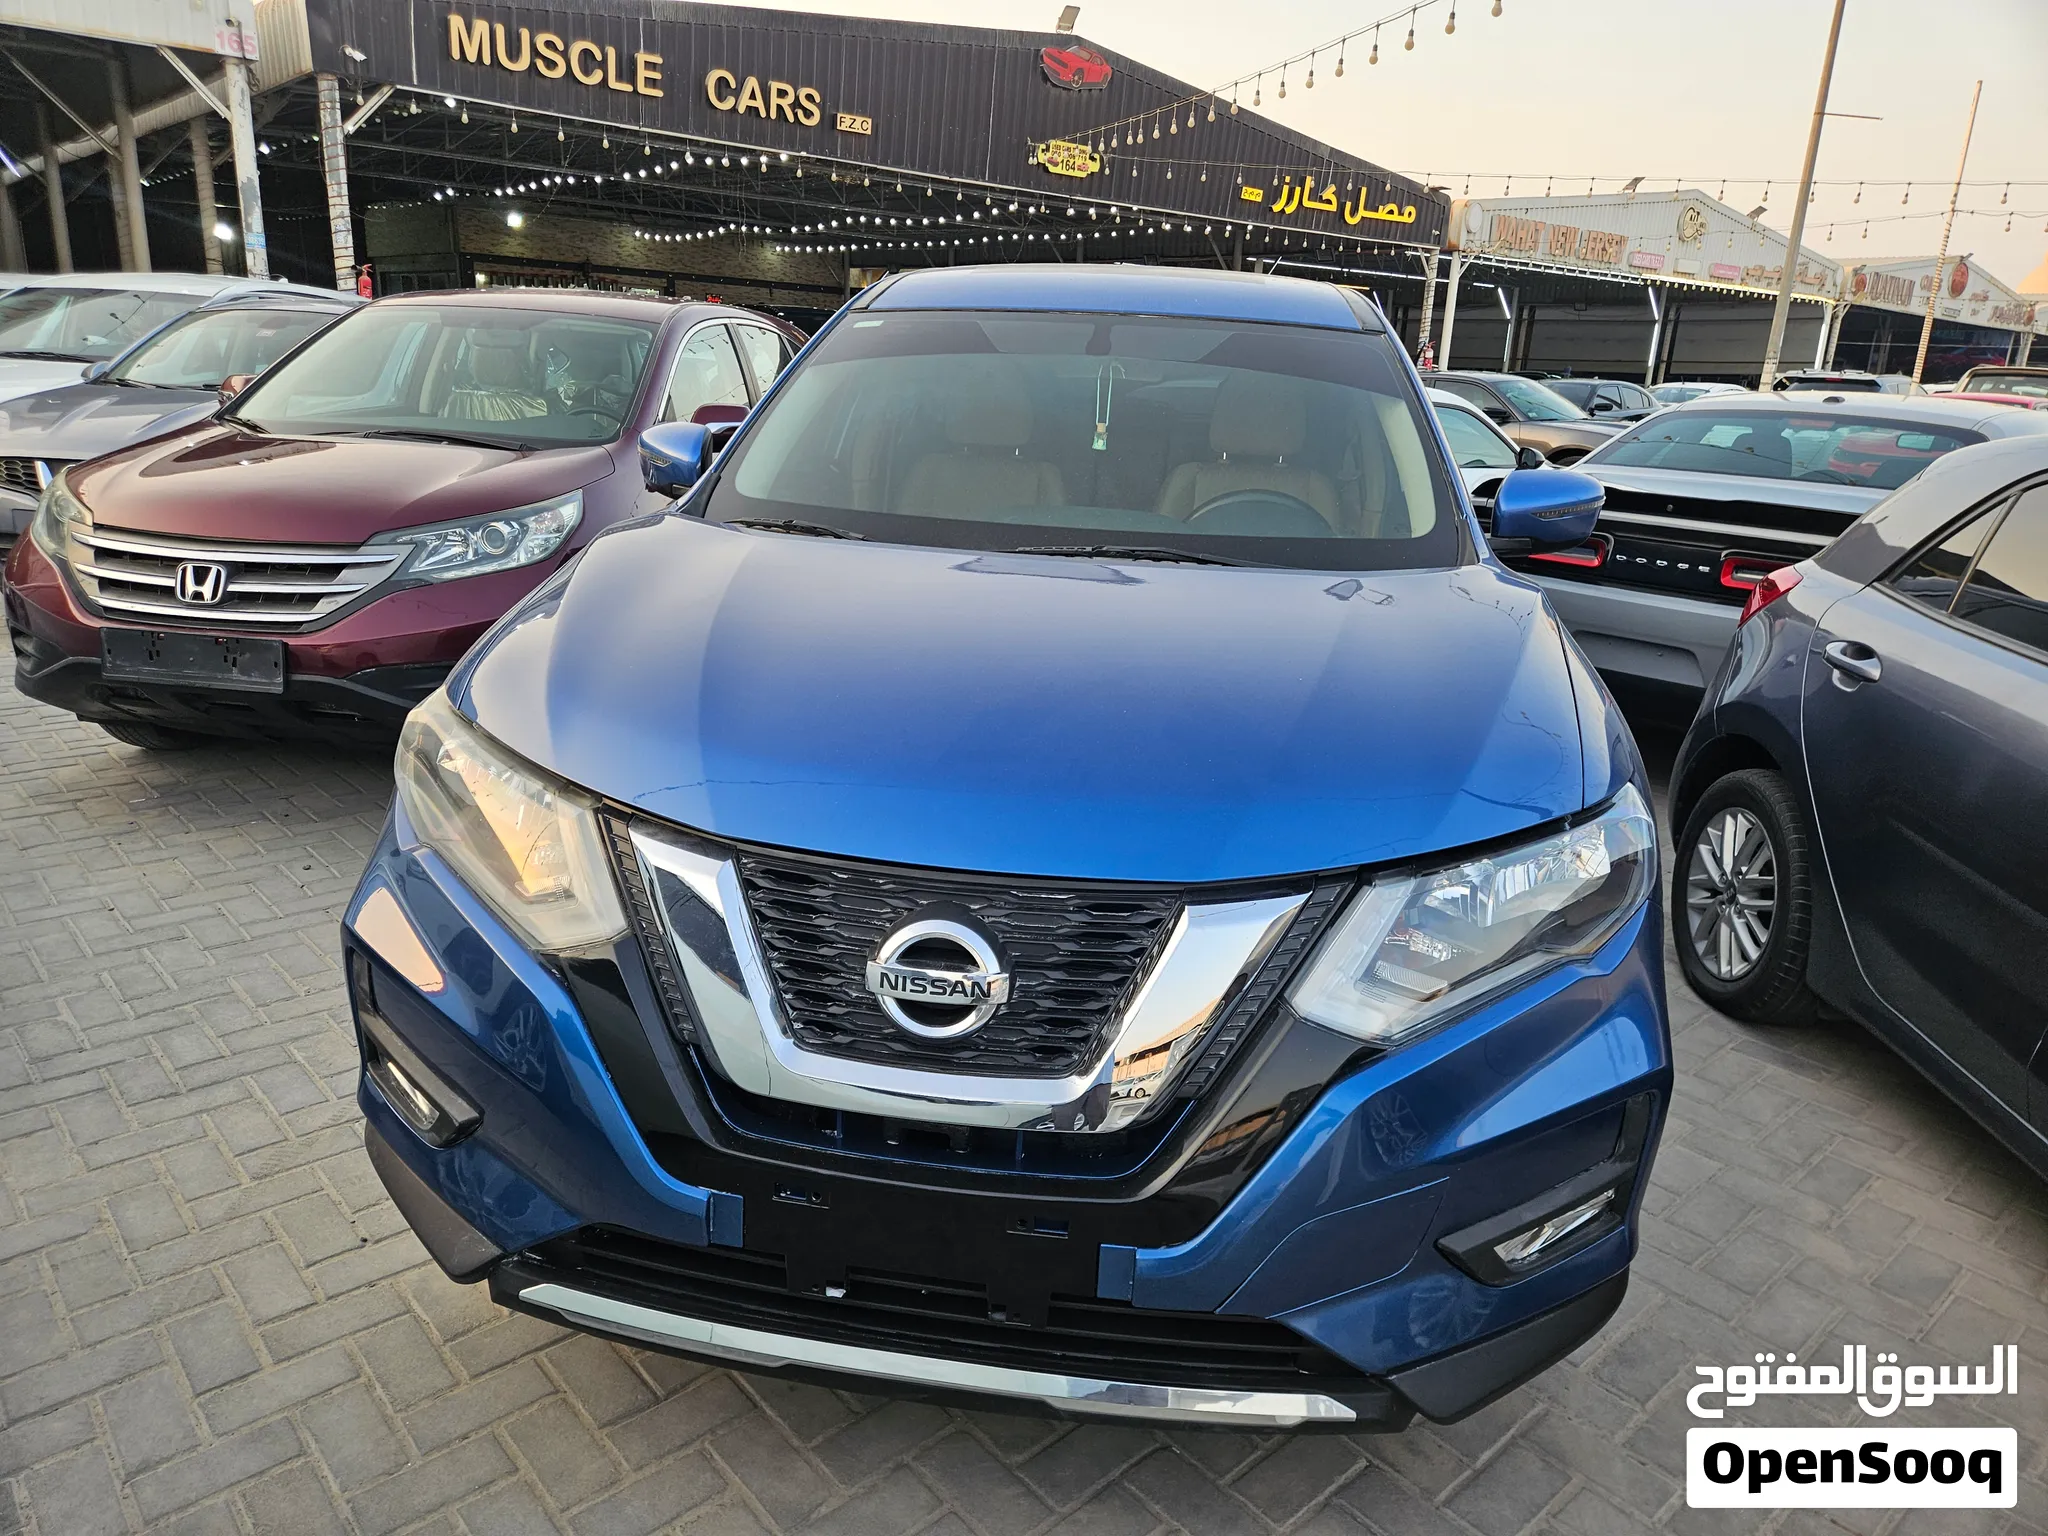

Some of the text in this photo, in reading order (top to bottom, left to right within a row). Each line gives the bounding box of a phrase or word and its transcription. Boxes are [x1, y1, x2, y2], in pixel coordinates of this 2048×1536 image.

[215, 30, 257, 56] 165
[447, 14, 870, 132] MUSCLE CARS F.Z.C
[1060, 158, 1076, 172] 164
[1271, 175, 1417, 226] مصل كارز
[1494, 213, 1547, 251] WAHAT
[1548, 224, 1581, 257] NEW
[1578, 229, 1630, 265] JERSEY
[1615, 554, 1711, 573] DODGE
[879, 971, 992, 999] NISSAN
